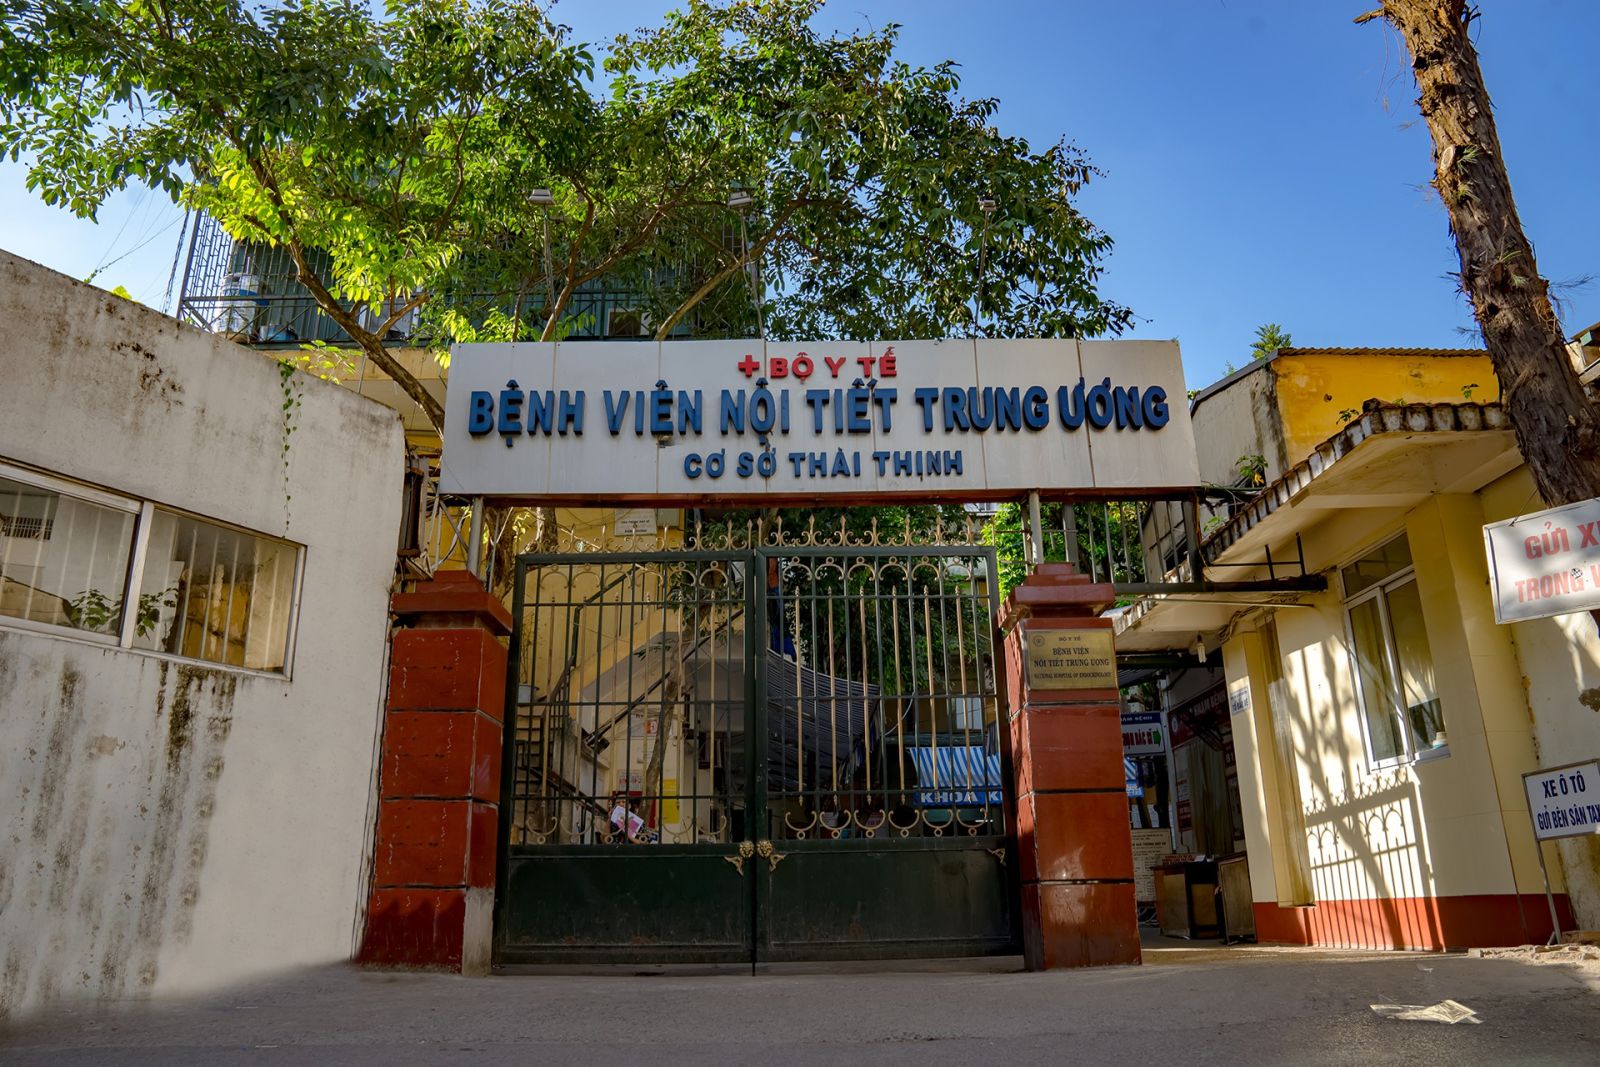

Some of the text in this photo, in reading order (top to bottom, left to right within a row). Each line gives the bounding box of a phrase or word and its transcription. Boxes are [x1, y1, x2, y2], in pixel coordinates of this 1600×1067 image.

[769, 346, 898, 384] BỘ Y TẾ
[468, 379, 586, 448] BỆNH
[720, 377, 790, 446] NỘI
[806, 378, 898, 434] TIẾT
[914, 385, 1050, 433] TRUNG
[1057, 377, 1170, 432] ƯƠNG
[683, 448, 726, 479] CƠ
[1524, 521, 1571, 561] GỬI
[1066, 659, 1089, 668] TRUNG
[920, 792, 978, 803] KHOA
[1542, 770, 1586, 798] XE Ô TÔ
